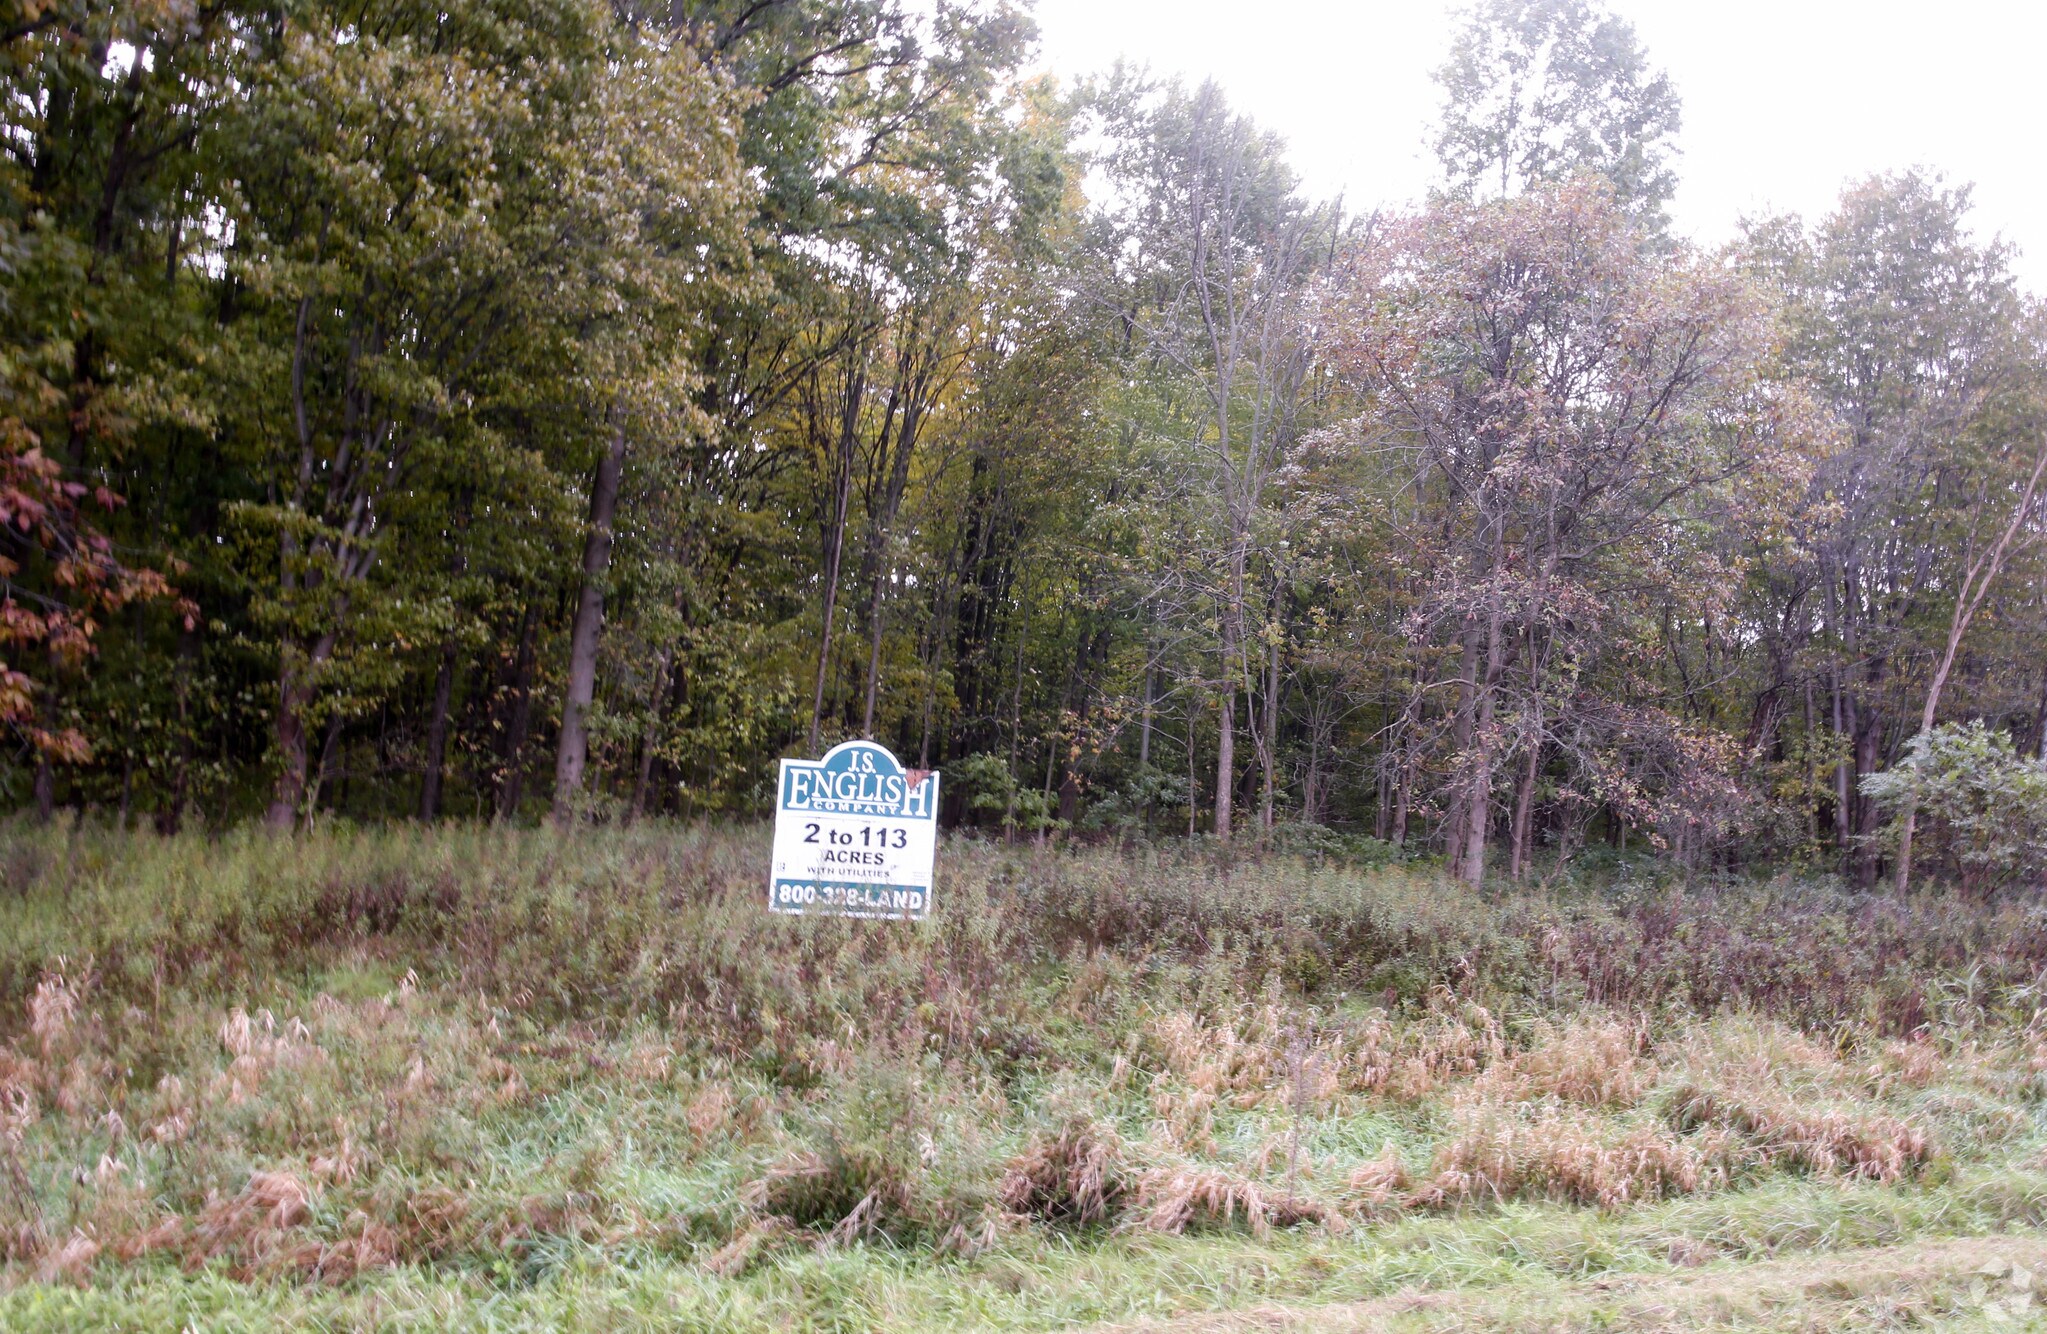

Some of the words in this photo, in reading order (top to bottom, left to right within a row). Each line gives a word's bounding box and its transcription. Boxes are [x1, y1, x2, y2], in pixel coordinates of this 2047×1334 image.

[848, 750, 876, 774] J.S.
[787, 768, 930, 817] ENGLISH
[813, 800, 899, 814] COMPANY
[804, 823, 820, 843] 2
[829, 829, 852, 845] to
[860, 827, 907, 848] 113
[824, 849, 884, 865] ACRES
[838, 869, 890, 878] UTILITIES
